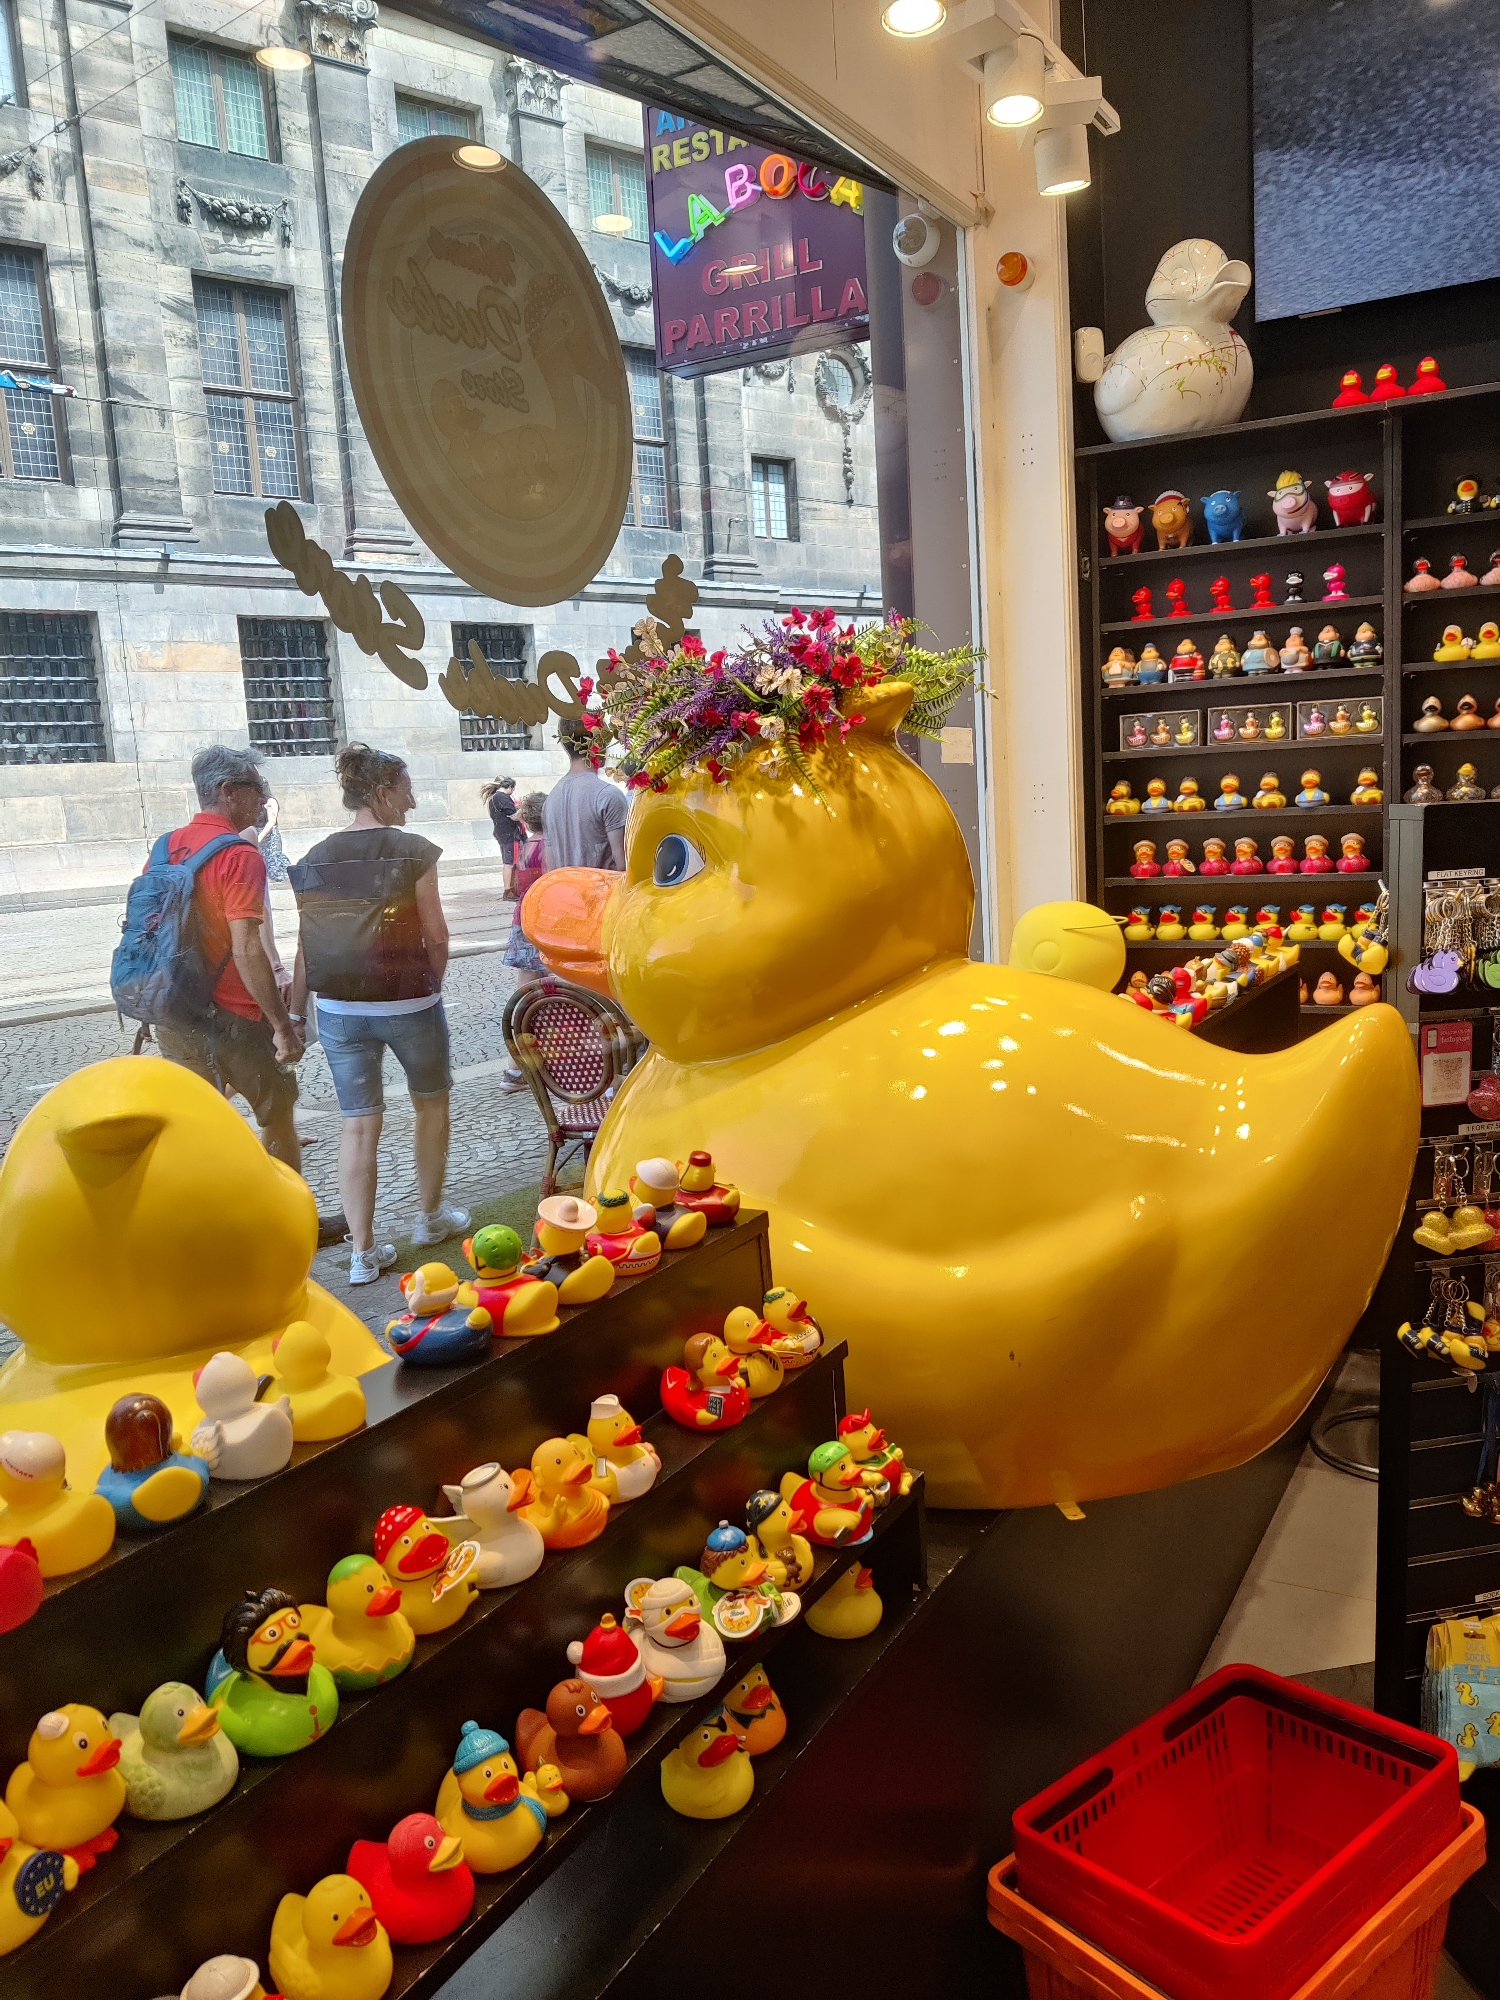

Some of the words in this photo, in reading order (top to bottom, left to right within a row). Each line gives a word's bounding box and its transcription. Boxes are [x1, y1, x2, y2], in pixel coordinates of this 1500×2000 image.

[653, 193, 726, 266] LA
[724, 153, 865, 217] BOCA
[702, 238, 823, 296] GRILL
[663, 277, 869, 355] PARRILLA
[1454, 869, 1484, 877] KEYRING
[1471, 1124, 1486, 1132] FOR
[1465, 1652, 1491, 1663] SOCKS
[34, 1872, 56, 1900] EU
